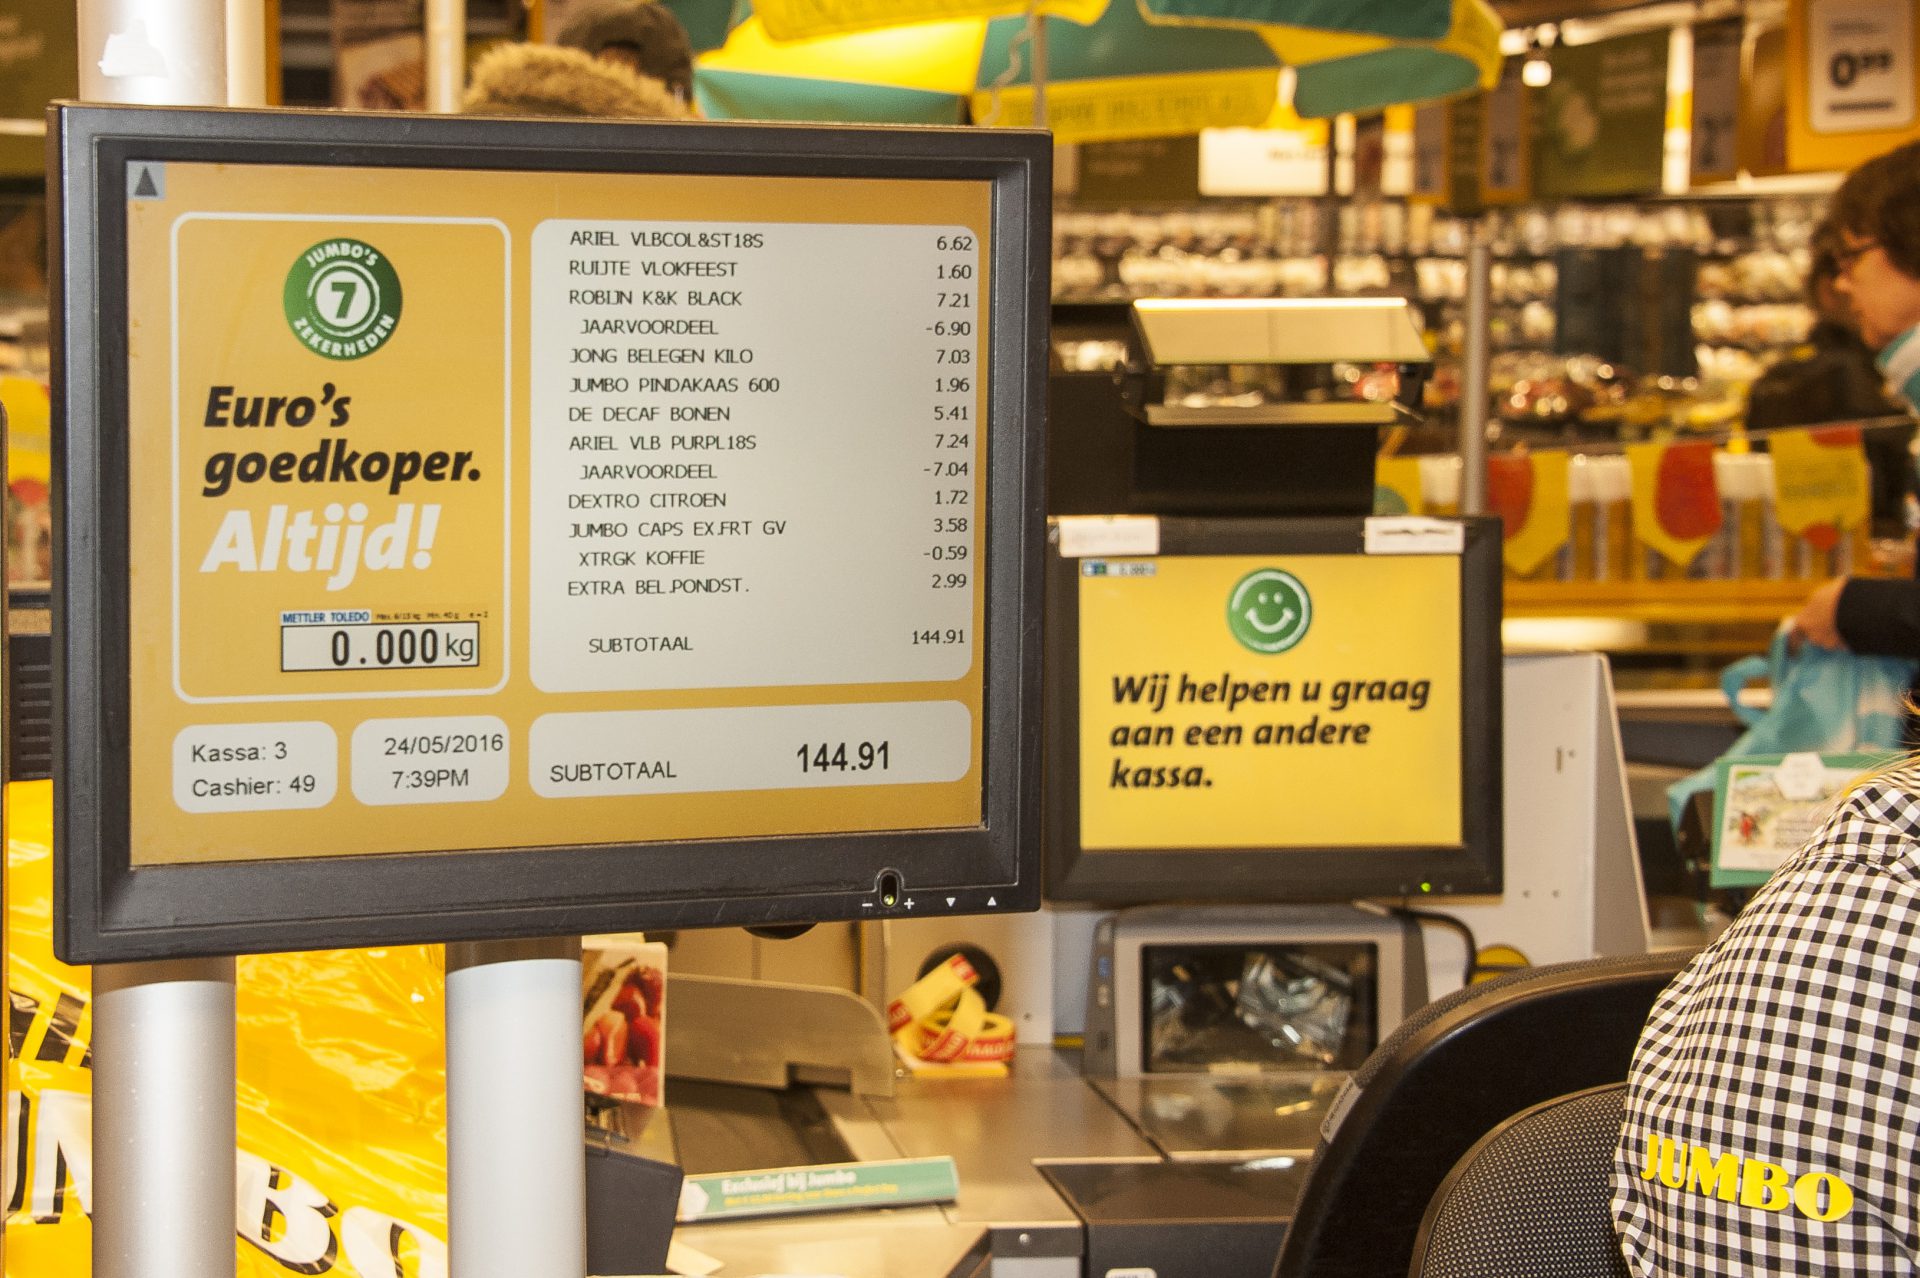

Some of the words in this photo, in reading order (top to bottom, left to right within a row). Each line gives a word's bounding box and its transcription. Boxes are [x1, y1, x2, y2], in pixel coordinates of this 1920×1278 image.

[570, 231, 619, 246] ARIEL
[631, 232, 763, 248] VLBCOL&ST18S
[937, 236, 971, 250] 6.62
[306, 242, 378, 268] JUMBO'S
[570, 260, 629, 275] RUIJTE
[641, 262, 738, 277] VLOKFEEST
[938, 265, 971, 279] 1.60
[331, 282, 357, 319] 7
[570, 290, 632, 305] ROBIJN
[643, 291, 677, 305] K&K
[688, 291, 742, 306] BLACK
[938, 293, 969, 307] 7.21
[581, 319, 718, 334] JAARVOORDEEL
[926, 321, 970, 336] -6.90
[294, 315, 394, 356] ZEKERHEDEN
[570, 348, 617, 363] JONG
[628, 349, 704, 363] BELEGEN
[715, 349, 753, 363] KILO
[937, 350, 970, 364] 7.03
[570, 378, 628, 392] JUMBO
[639, 378, 738, 392] PINDAKAAS
[749, 378, 779, 392] 600
[936, 378, 969, 392] 1.96
[204, 382, 351, 427] Euro's
[569, 407, 591, 421] DE
[603, 407, 659, 421] DECAF
[671, 407, 730, 421] BONEN
[935, 406, 967, 420] 5.41
[569, 436, 617, 450] ARIEL
[630, 436, 661, 450] VLB
[672, 435, 756, 450] PURPL18S
[936, 434, 968, 448] 7.24
[203, 438, 480, 497] goedkoper.
[581, 464, 717, 479] JAARVOORDEEL
[924, 462, 967, 476] -7.04
[569, 494, 639, 509] DEXTRO
[650, 493, 726, 508] CITROEN
[936, 490, 968, 504] 1.72
[569, 523, 627, 538] JUMBO
[639, 522, 683, 537] CAPS
[694, 521, 752, 536] EX.FRT
[763, 521, 786, 535] GV
[934, 518, 967, 532] 3.58
[200, 502, 441, 591] Altijd!
[924, 546, 967, 560] -0.59
[580, 552, 635, 566] XTRGK
[647, 550, 704, 565] KOFFIE
[568, 581, 624, 596] EXTRA
[636, 578, 749, 594] BEL.PONDST.
[932, 574, 966, 588] 2.99
[282, 612, 325, 623] METTLER
[331, 611, 369, 622] TOLEDO
[589, 637, 693, 653] SUBTOTAAL
[913, 630, 964, 644] 144.91
[332, 628, 438, 666] 0.000
[446, 633, 474, 662] kg
[1113, 674, 1169, 712] Wij
[1178, 673, 1290, 711] helpen
[1302, 682, 1321, 701] u
[1331, 679, 1430, 711] graag
[1110, 725, 1174, 747] aan
[1184, 725, 1242, 746] een
[1253, 716, 1370, 746] andere
[192, 744, 266, 763] Kassa:
[275, 741, 288, 760] 3
[385, 734, 503, 755] 24/05/2016
[797, 741, 888, 773] 144.91
[392, 768, 468, 789] 7:39PM
[550, 761, 677, 782] SUBTOTAAL
[1110, 759, 1213, 789] kassa.
[192, 777, 280, 797] Cashier:
[289, 775, 315, 793] 49
[1640, 1134, 1854, 1222] JUMBO
